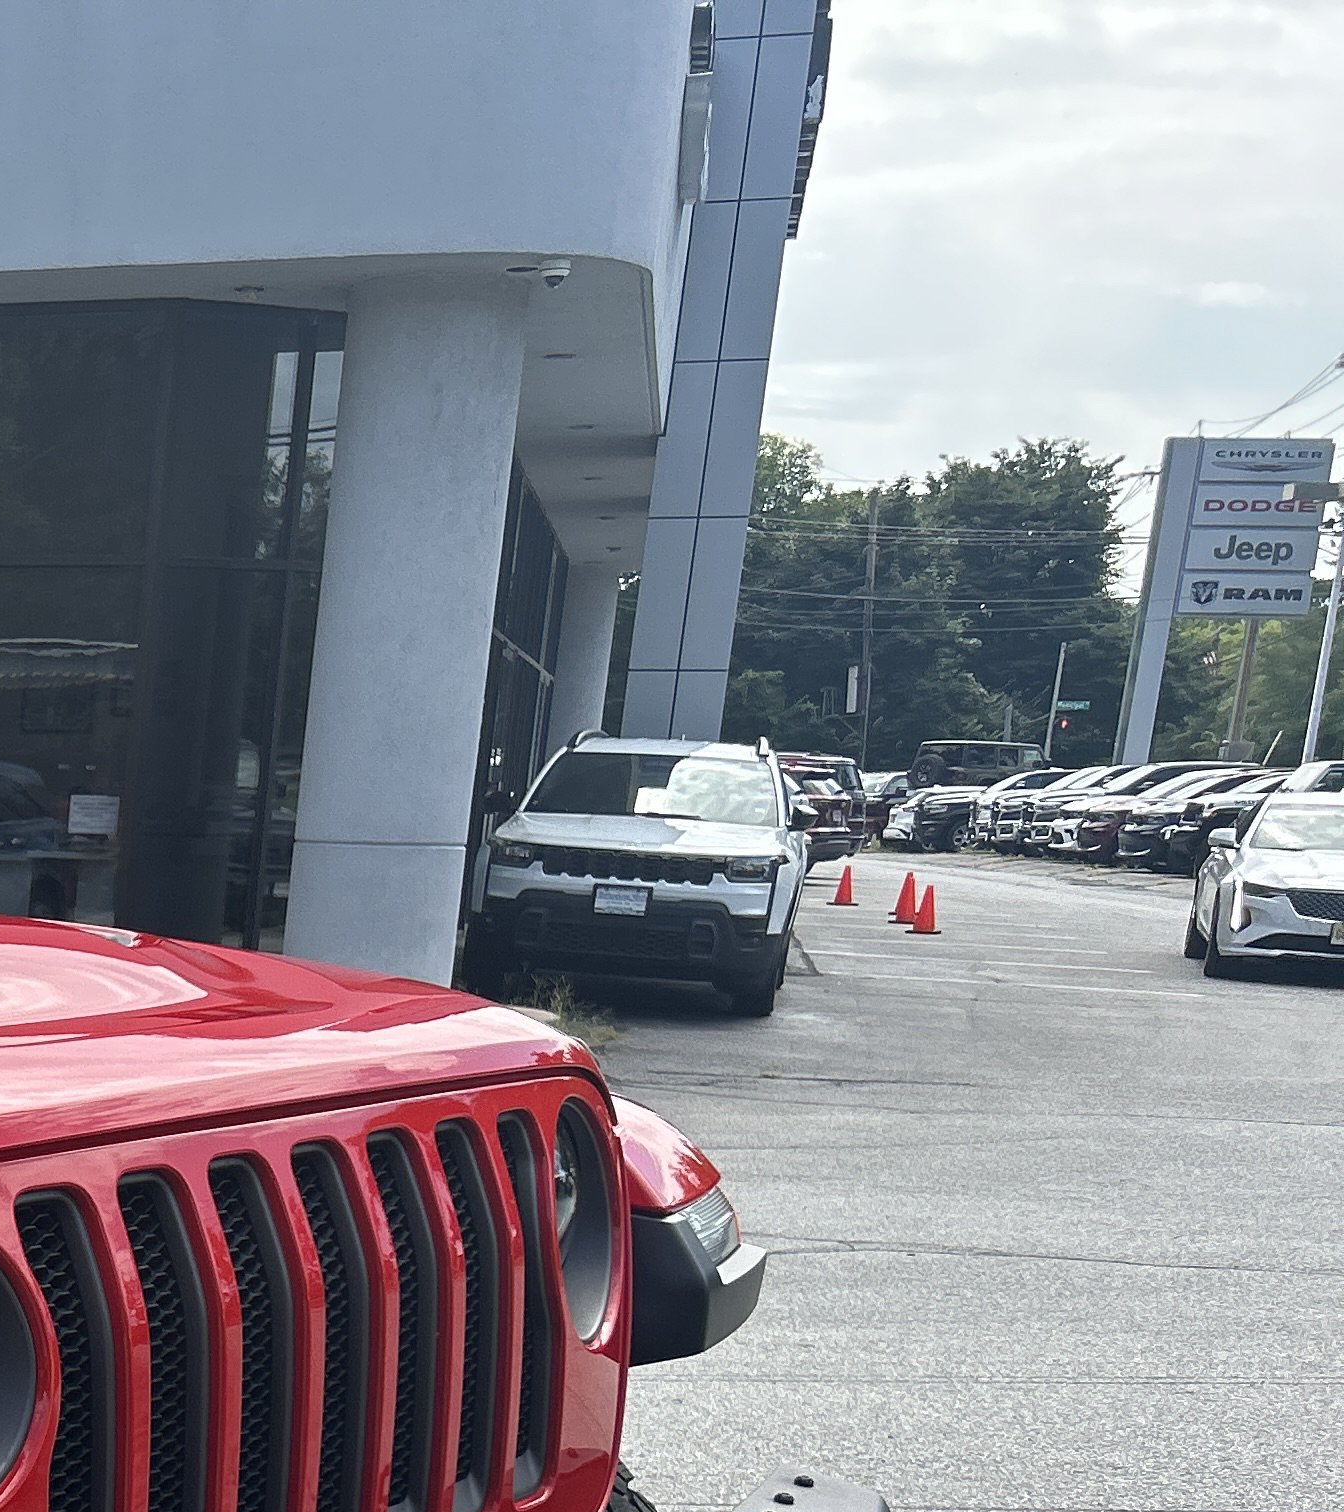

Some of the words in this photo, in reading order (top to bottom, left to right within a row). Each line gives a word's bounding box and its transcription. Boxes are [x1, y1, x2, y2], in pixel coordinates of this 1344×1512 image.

[1215, 450, 1323, 459] CHRYSLER
[1203, 499, 1318, 513] DODGE
[1213, 534, 1293, 566] Jeep
[1223, 588, 1303, 601] RAM
